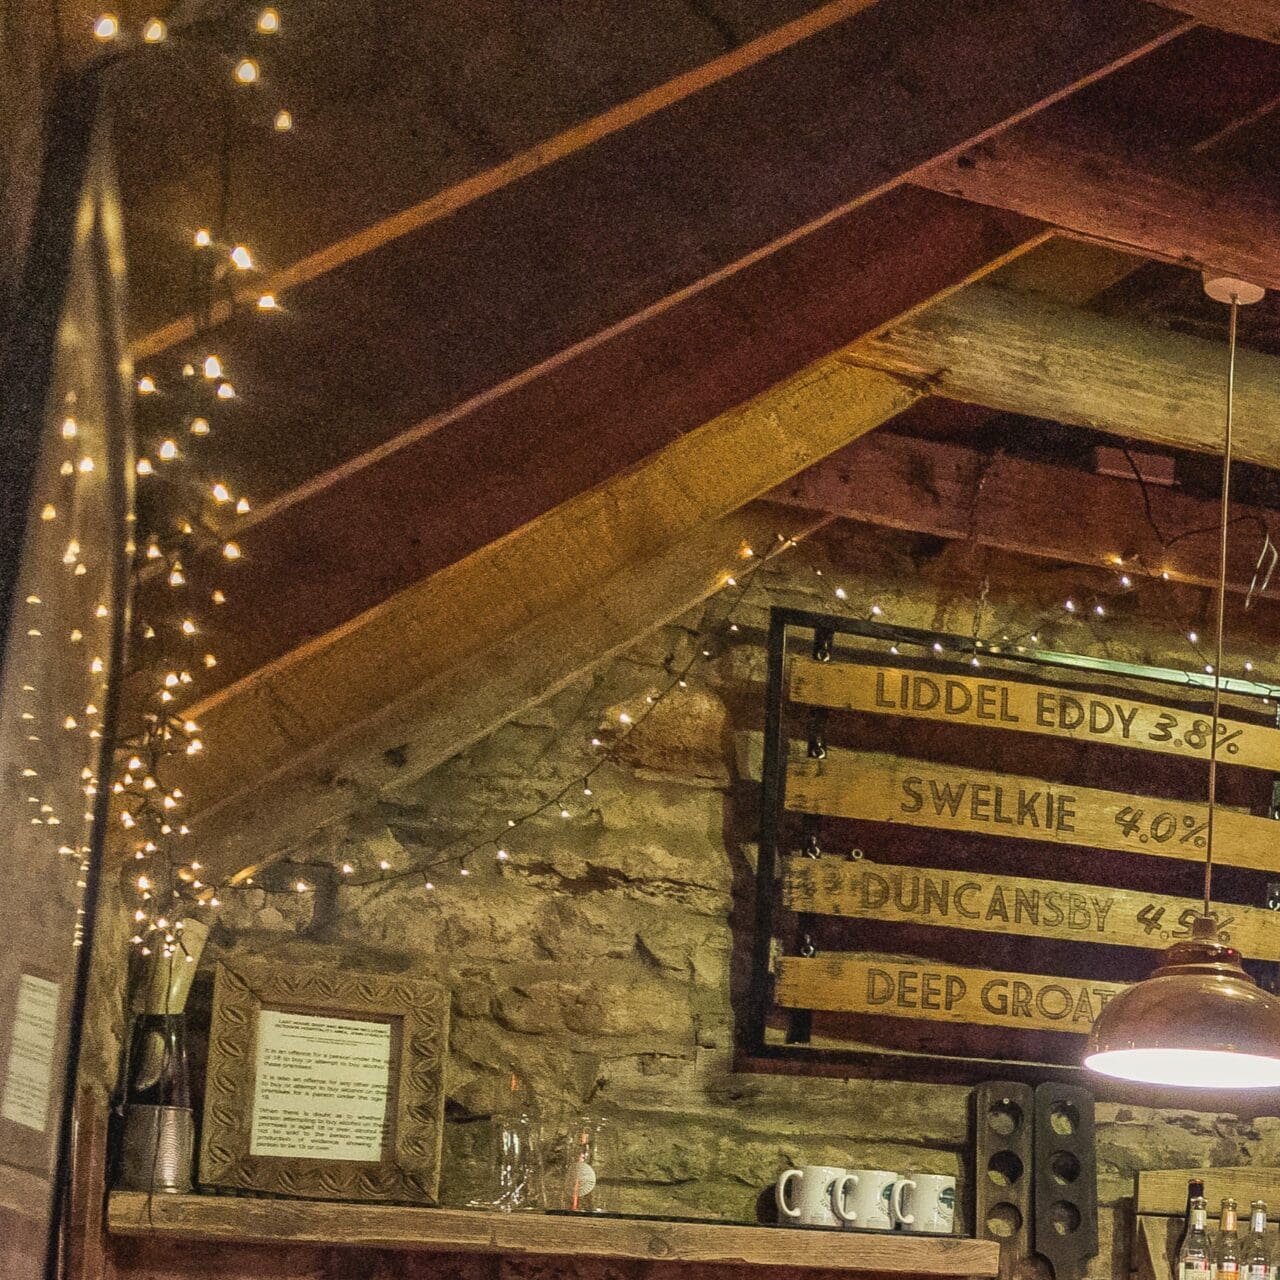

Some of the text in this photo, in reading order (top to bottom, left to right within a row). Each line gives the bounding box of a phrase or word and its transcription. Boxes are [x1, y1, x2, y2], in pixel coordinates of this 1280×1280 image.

[874, 672, 1246, 756] LIDDEL EDDY 3.8%
[899, 776, 1209, 849] SWELKIE 4.0%
[860, 872, 1115, 933] DUNCANSBY
[866, 967, 968, 1012] DEEP
